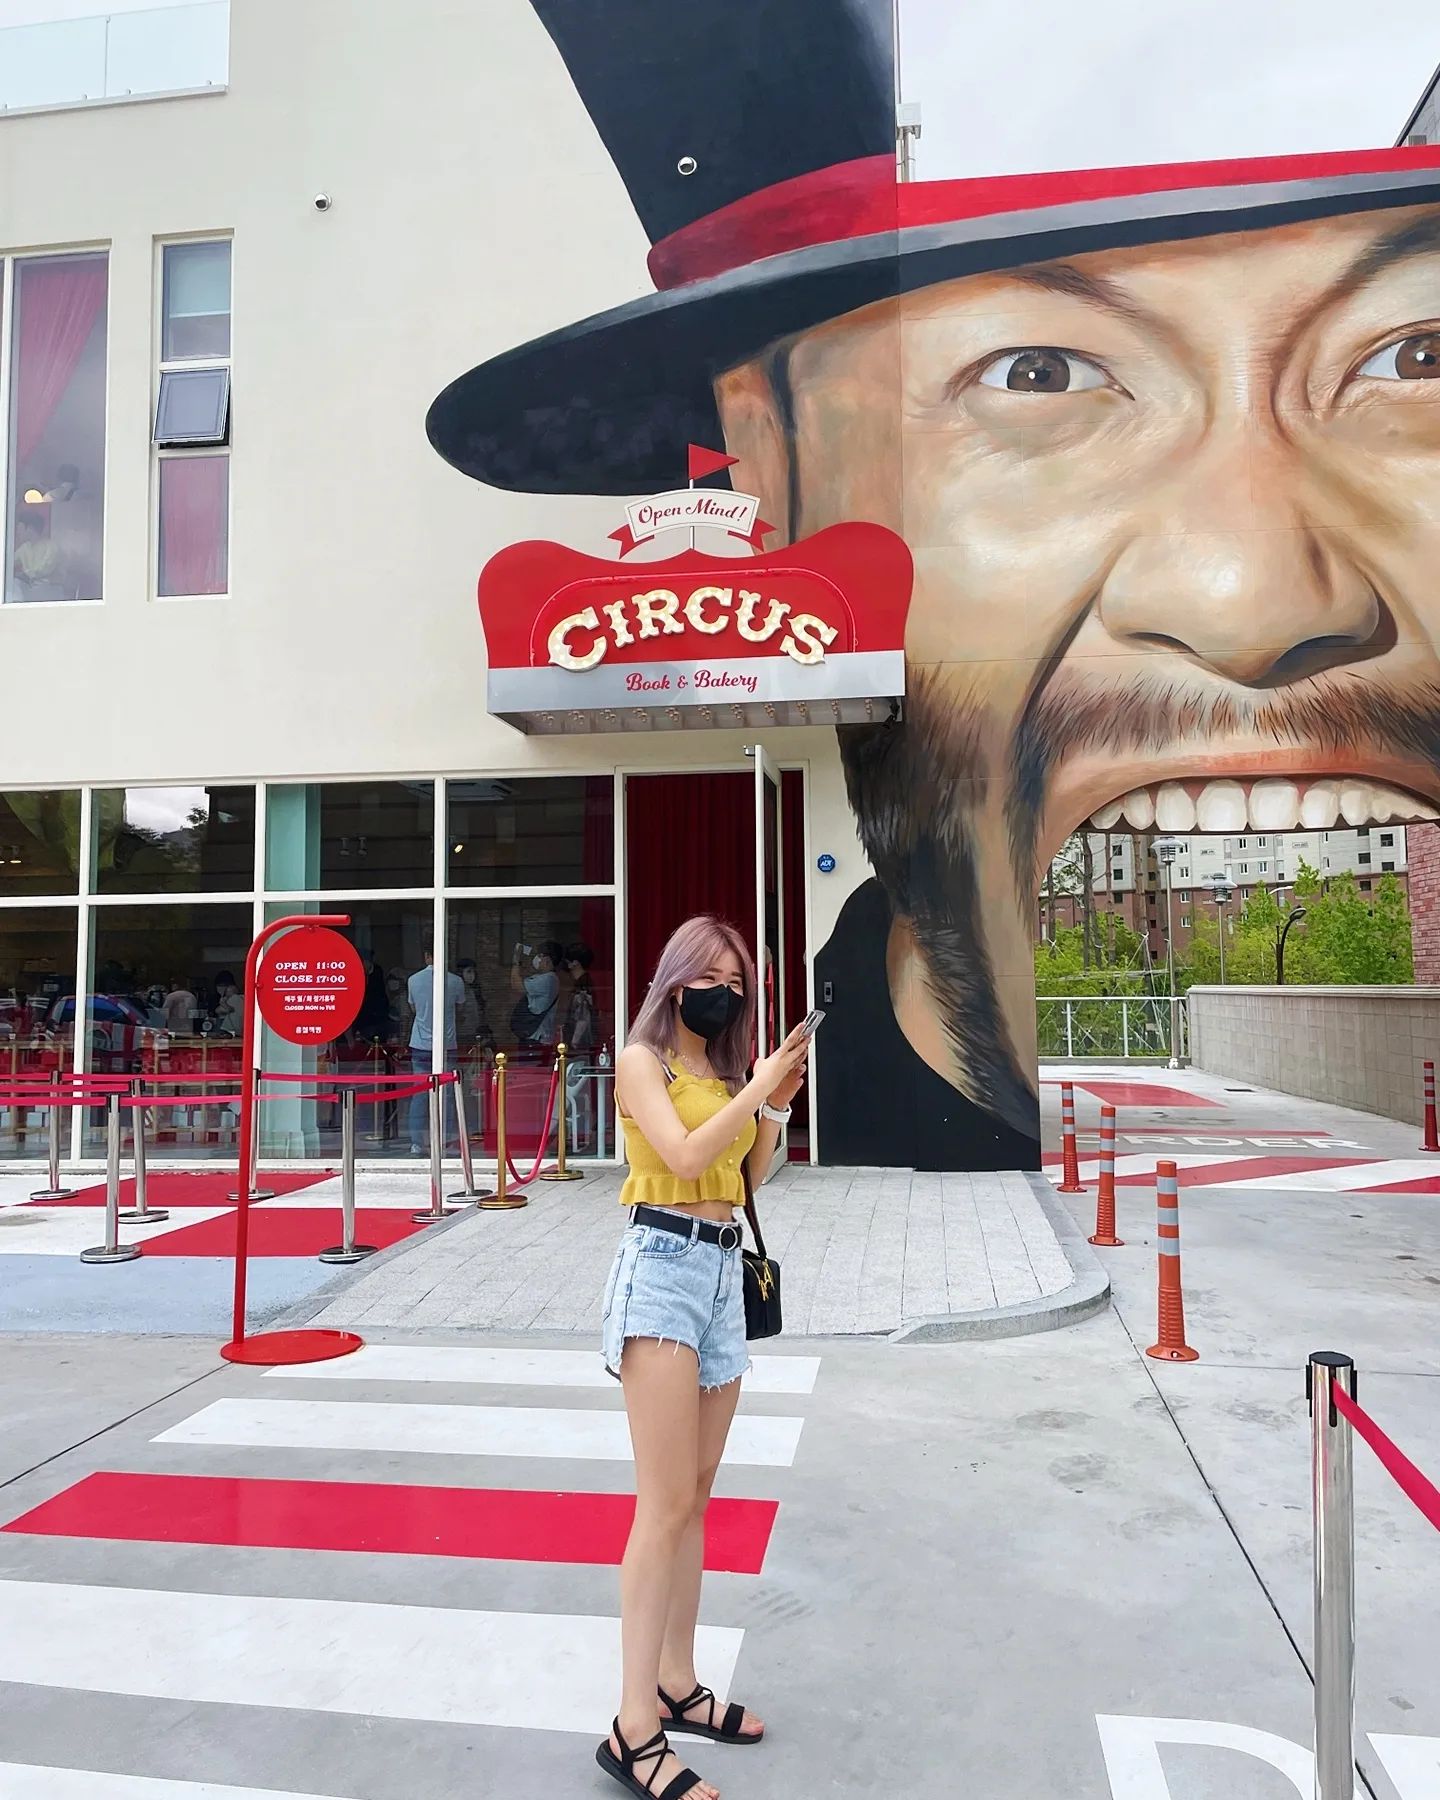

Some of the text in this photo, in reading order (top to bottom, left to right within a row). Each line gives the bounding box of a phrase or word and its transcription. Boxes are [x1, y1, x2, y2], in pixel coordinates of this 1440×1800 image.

[638, 498, 749, 527] Open Mind!
[547, 586, 839, 672] CIRCUS
[625, 669, 758, 694] Book & Bakery
[275, 962, 307, 970] OPEN
[275, 975, 345, 983] CLOSE 17:00
